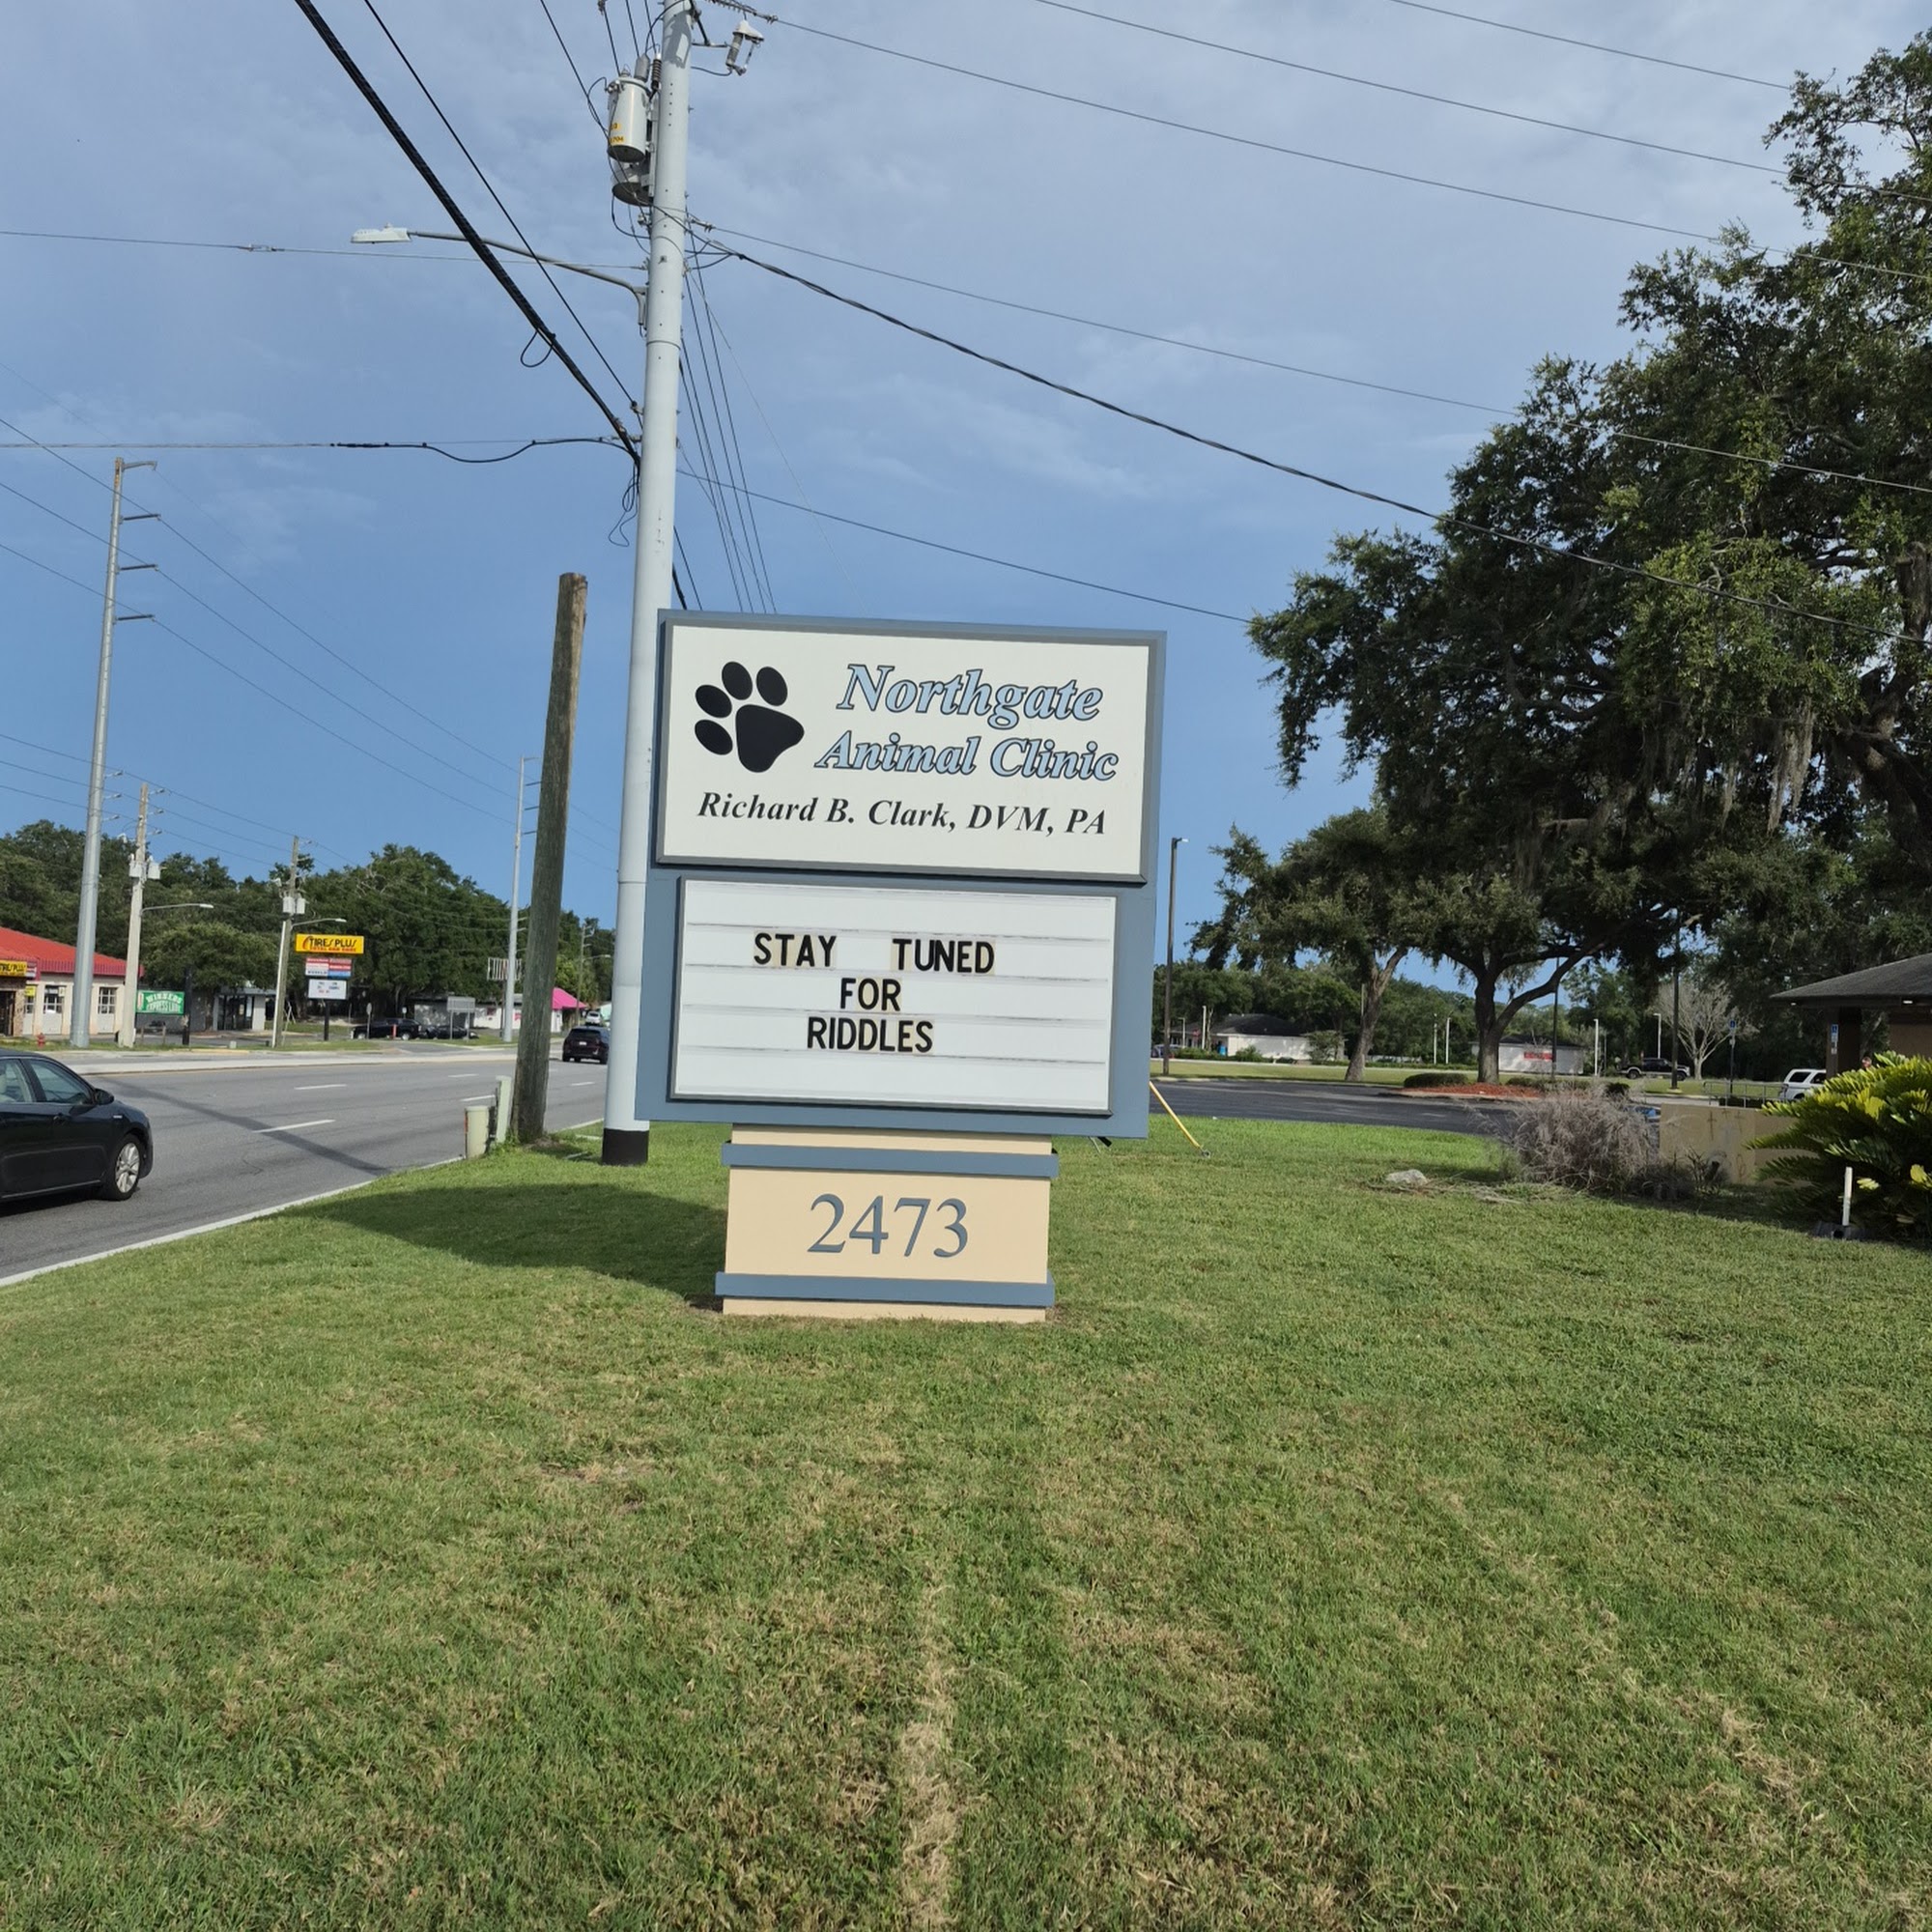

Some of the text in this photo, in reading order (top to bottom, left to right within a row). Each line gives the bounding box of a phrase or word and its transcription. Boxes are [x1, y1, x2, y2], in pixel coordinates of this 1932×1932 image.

[836, 663, 1104, 730] Northgate
[813, 729, 1121, 781] Animal Clinic
[696, 791, 1106, 838] Richard B. Clark, DVM, PA
[334, 938, 357, 948] PLUS
[753, 932, 996, 974] STAY TUNED
[839, 978, 902, 1012] FOR
[808, 1017, 934, 1053] RIDDLES
[808, 1193, 969, 1259] 2473
